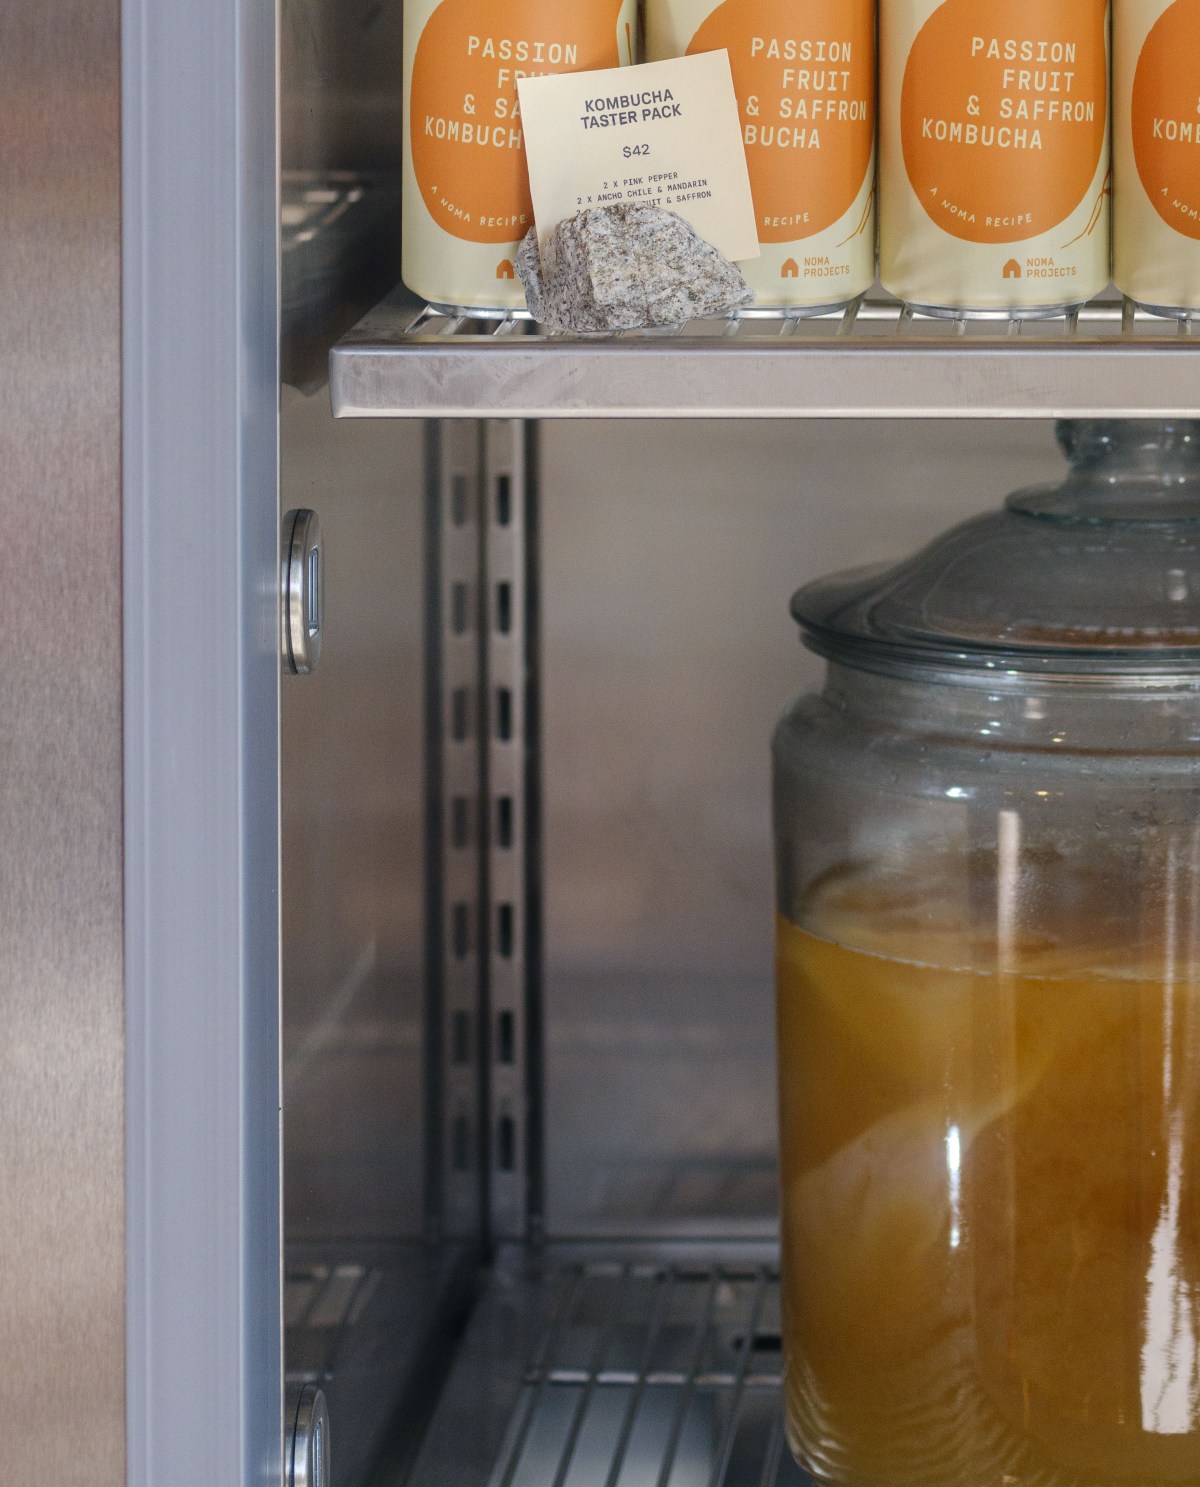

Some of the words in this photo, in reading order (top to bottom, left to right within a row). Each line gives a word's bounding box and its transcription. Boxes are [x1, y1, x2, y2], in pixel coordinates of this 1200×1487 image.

[467, 35, 578, 66] PASSION
[751, 36, 852, 63] PASSION
[971, 36, 1076, 63] PASSION
[782, 69, 850, 92] FRUIT
[1002, 69, 1075, 93] FRUIT
[585, 88, 674, 113] KOMBUCHA
[746, 94, 760, 117] &
[779, 98, 867, 122] SAFFRON
[966, 95, 980, 117] &
[999, 98, 1095, 122] SAFFRON
[580, 110, 638, 130] TASTER
[642, 103, 682, 122] PACK
[425, 115, 521, 150] KOMBUCH
[744, 125, 820, 150] BUCHA
[922, 118, 1043, 151] KOMBUCHA
[622, 143, 651, 159] $42
[577, 197, 582, 205] 2
[587, 195, 592, 203] X
[597, 192, 623, 202] ANCHO
[627, 187, 652, 198] CHILE
[667, 179, 707, 192] MANDARIN
[613, 180, 618, 188] X
[623, 176, 643, 187] PINK
[648, 172, 678, 183] PEPPER
[666, 196, 672, 204] &
[676, 190, 712, 203] SAFFRON
[930, 186, 938, 196] A
[941, 199, 976, 224] NOMA
[986, 213, 1032, 227] RECIPE
[804, 256, 830, 266] NOMA
[804, 265, 850, 277] PROJECTS
[1027, 257, 1054, 267] NOMA
[1027, 266, 1076, 278] PROJECTS
